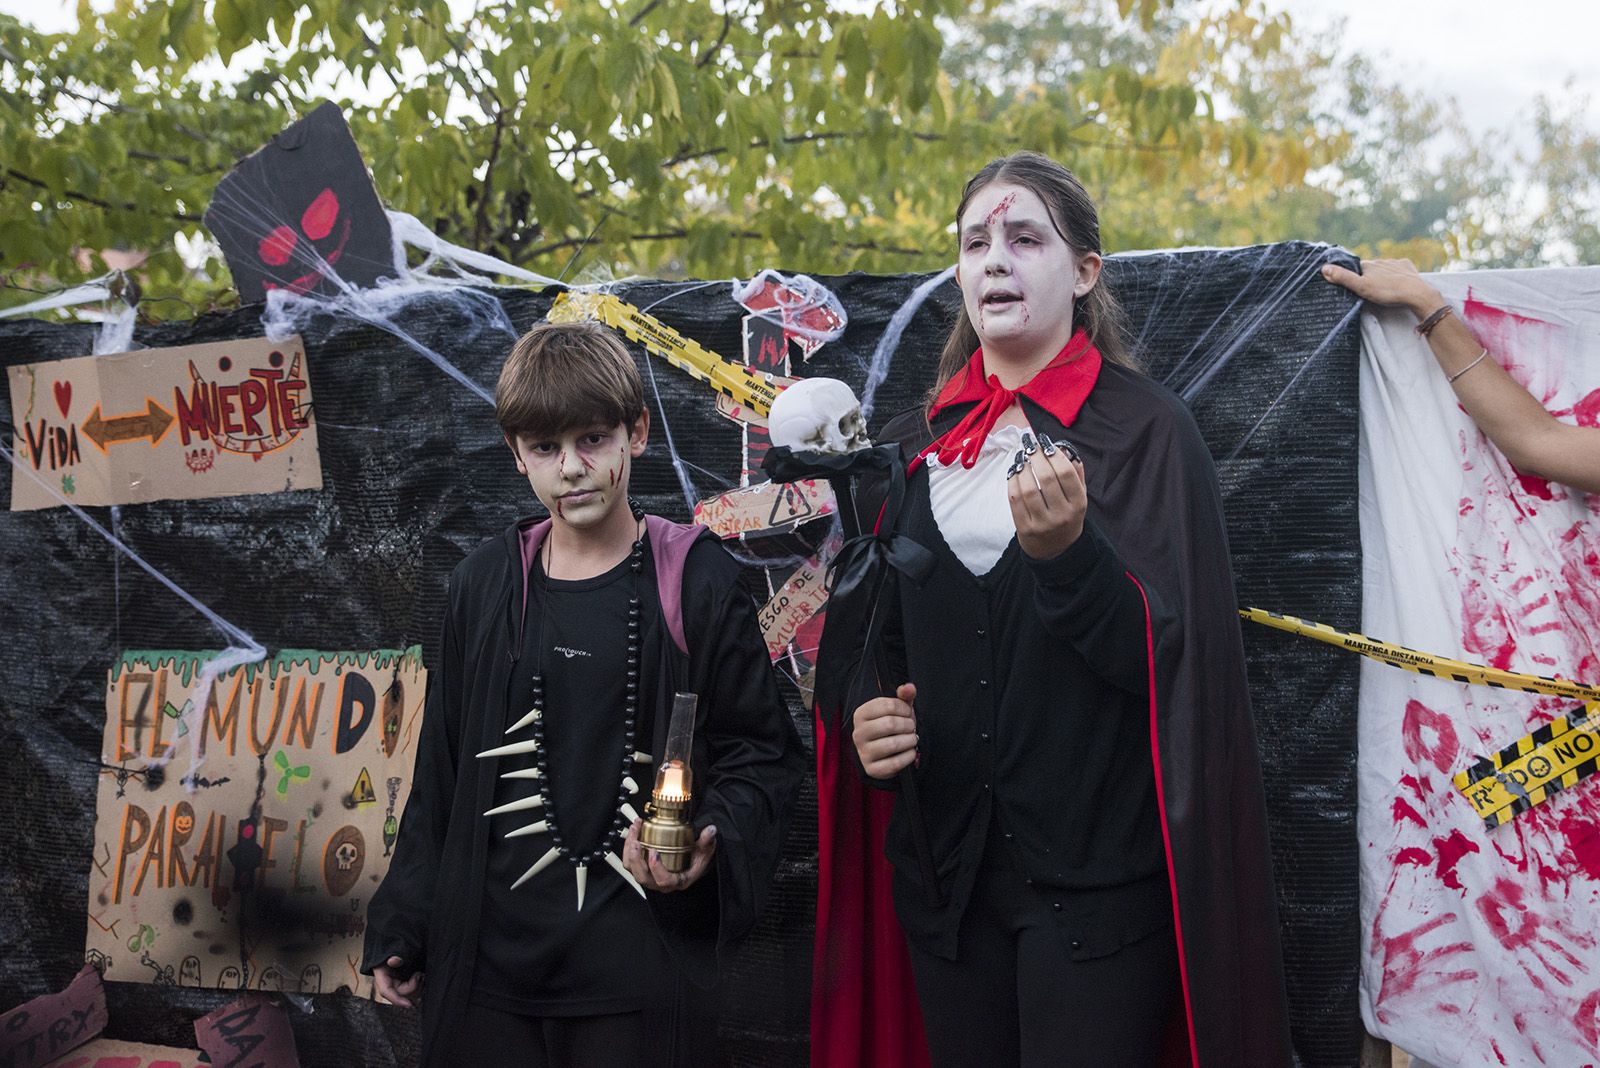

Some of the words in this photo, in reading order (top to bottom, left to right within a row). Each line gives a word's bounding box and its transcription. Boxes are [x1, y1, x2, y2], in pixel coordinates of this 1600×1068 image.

[174, 368, 310, 446] MUERTE
[761, 596, 789, 635] ESGO
[1344, 639, 1388, 655] MANTENGA
[1391, 650, 1434, 665] DISTANCIA
